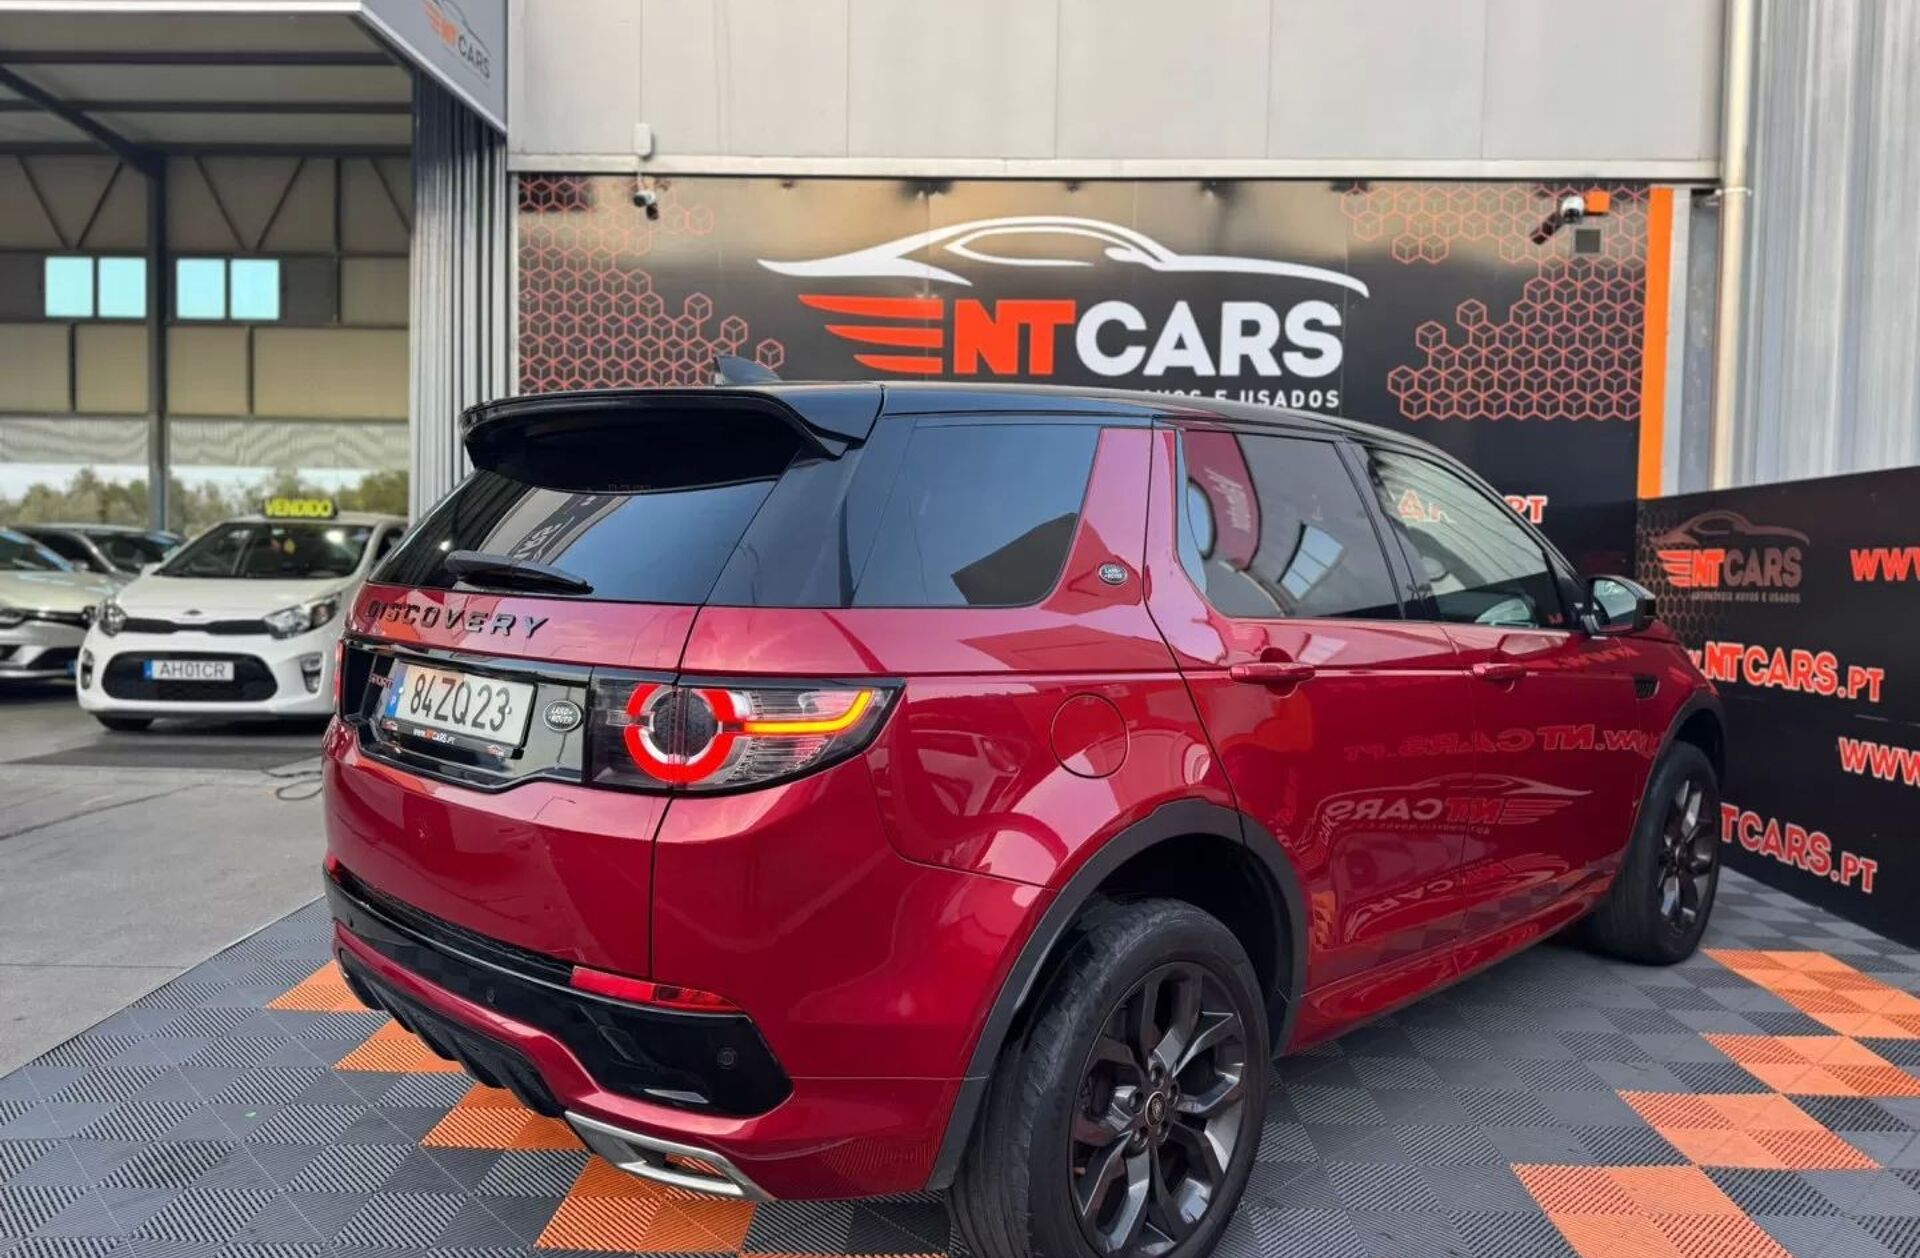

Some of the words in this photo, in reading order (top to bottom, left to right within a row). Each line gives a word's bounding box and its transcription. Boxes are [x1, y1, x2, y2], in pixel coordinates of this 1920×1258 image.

[953, 299, 1344, 378] NTCARS
[1240, 389, 1340, 409] USADOS
[264, 499, 334, 518] VENDIDO
[367, 600, 550, 639] DISCOVERY
